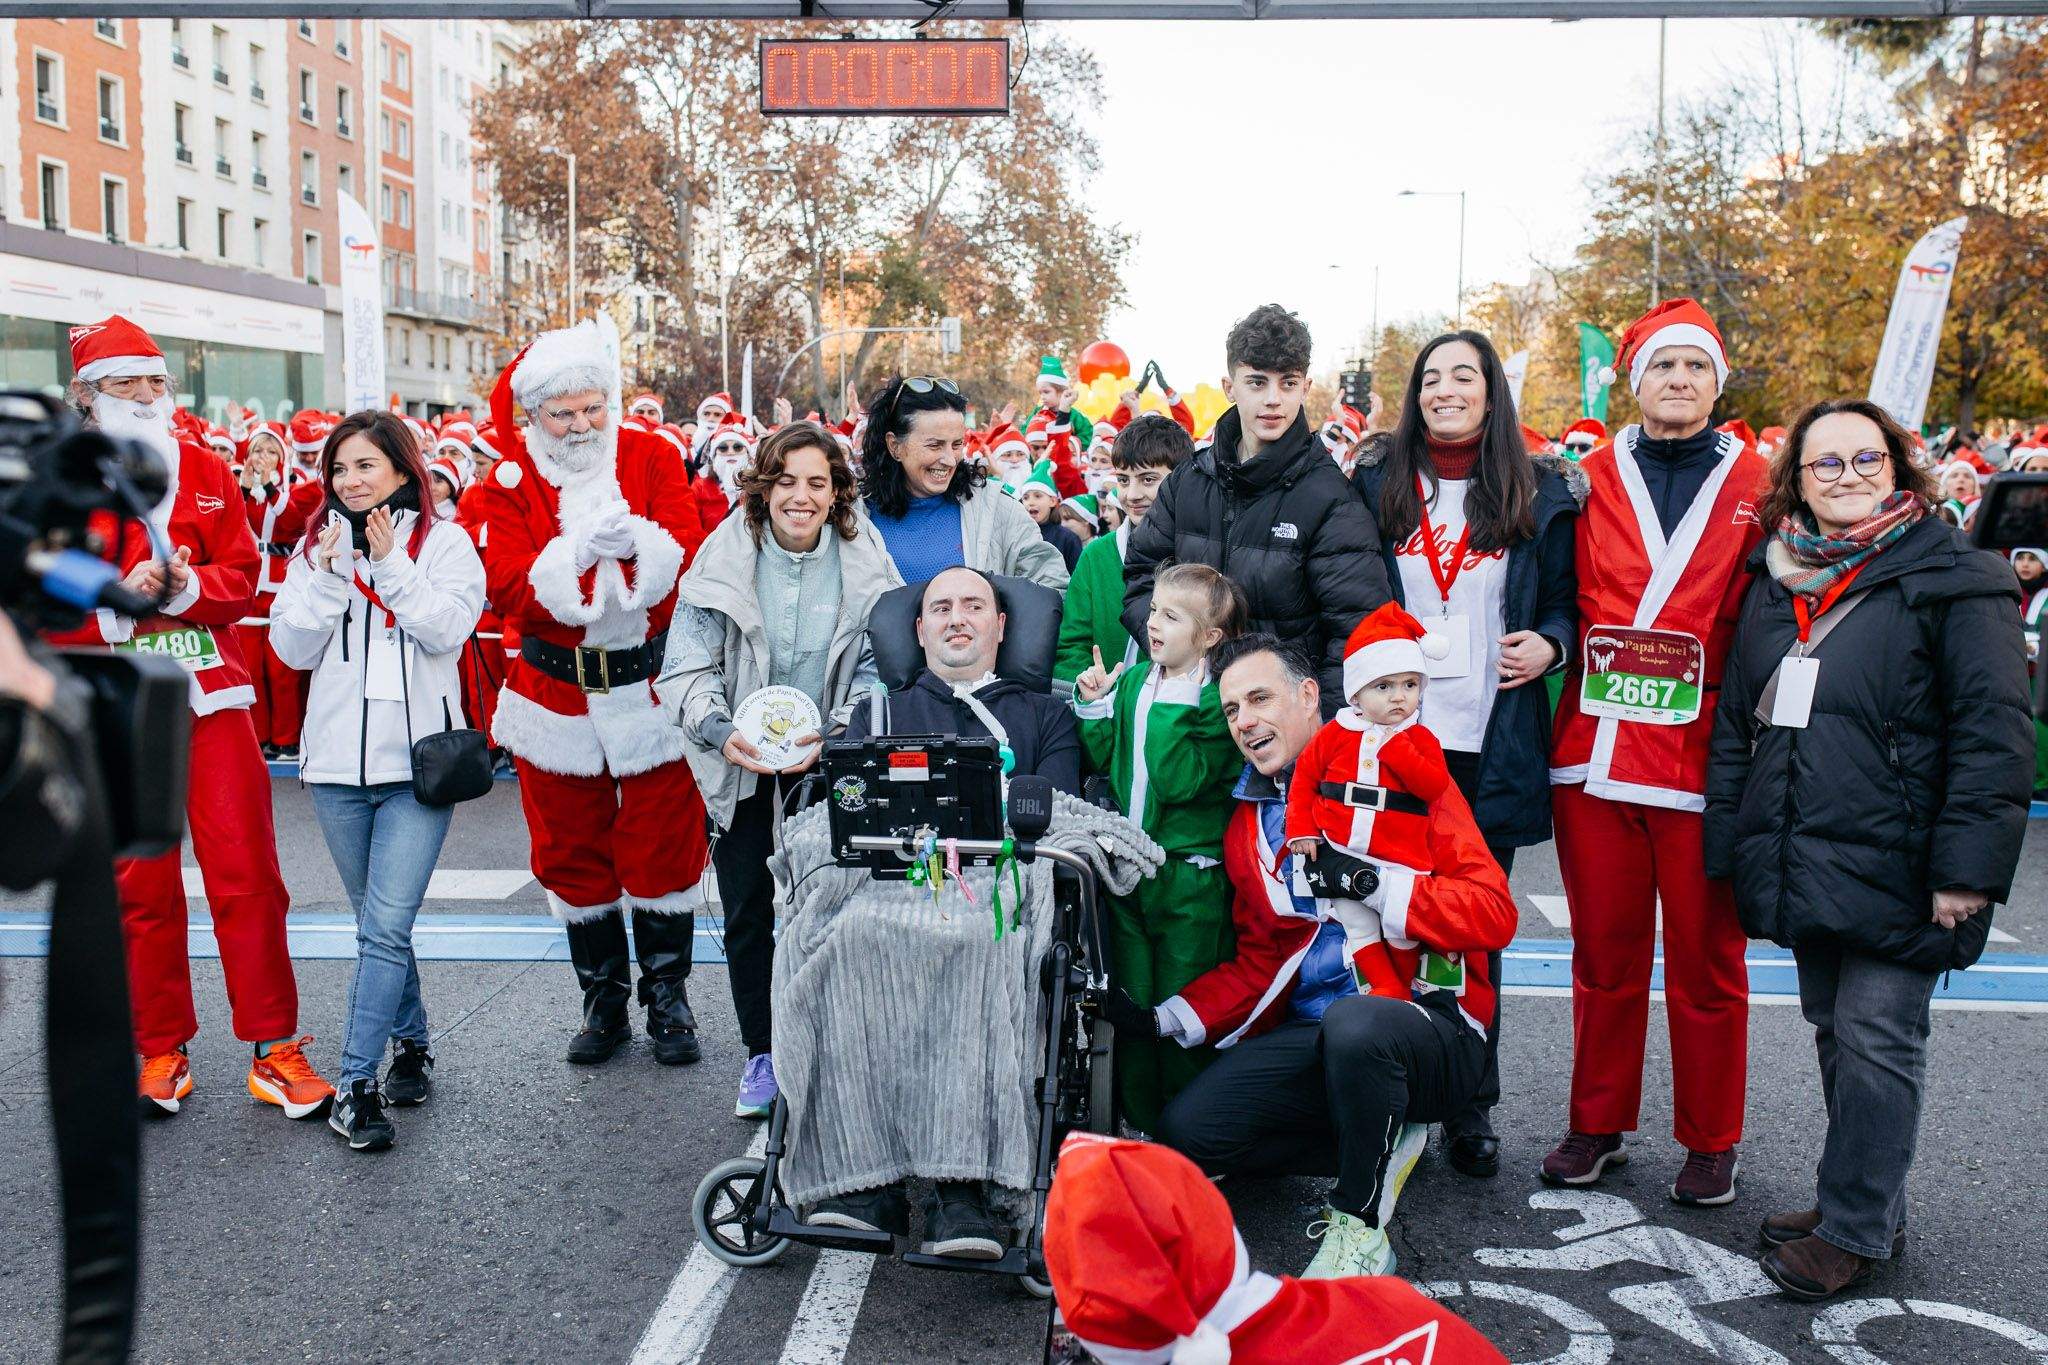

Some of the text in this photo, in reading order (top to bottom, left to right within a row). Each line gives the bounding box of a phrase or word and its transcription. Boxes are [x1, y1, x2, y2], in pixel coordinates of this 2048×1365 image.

[768, 48, 997, 105] 00:00:00
[135, 630, 201, 658] 5480
[1625, 640, 1687, 656] Papá Noel
[1605, 673, 1677, 707] 2667
[1016, 798, 1044, 815] JBL
